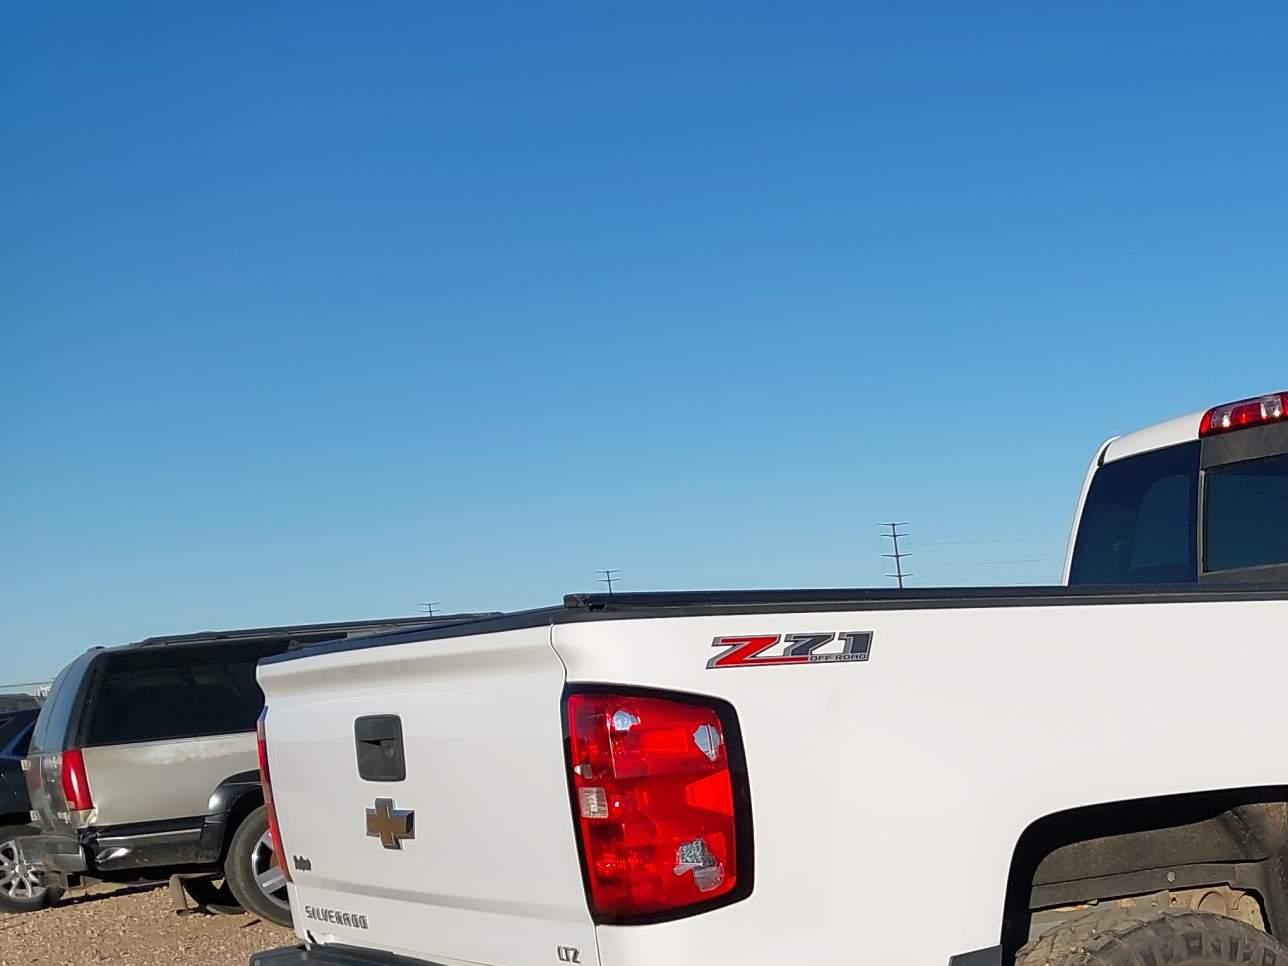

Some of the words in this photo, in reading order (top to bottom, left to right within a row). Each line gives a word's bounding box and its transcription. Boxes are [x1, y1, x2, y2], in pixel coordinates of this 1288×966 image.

[705, 631, 874, 669] Z71
[304, 905, 368, 929] SILVERADO
[557, 943, 581, 964] LTZ
